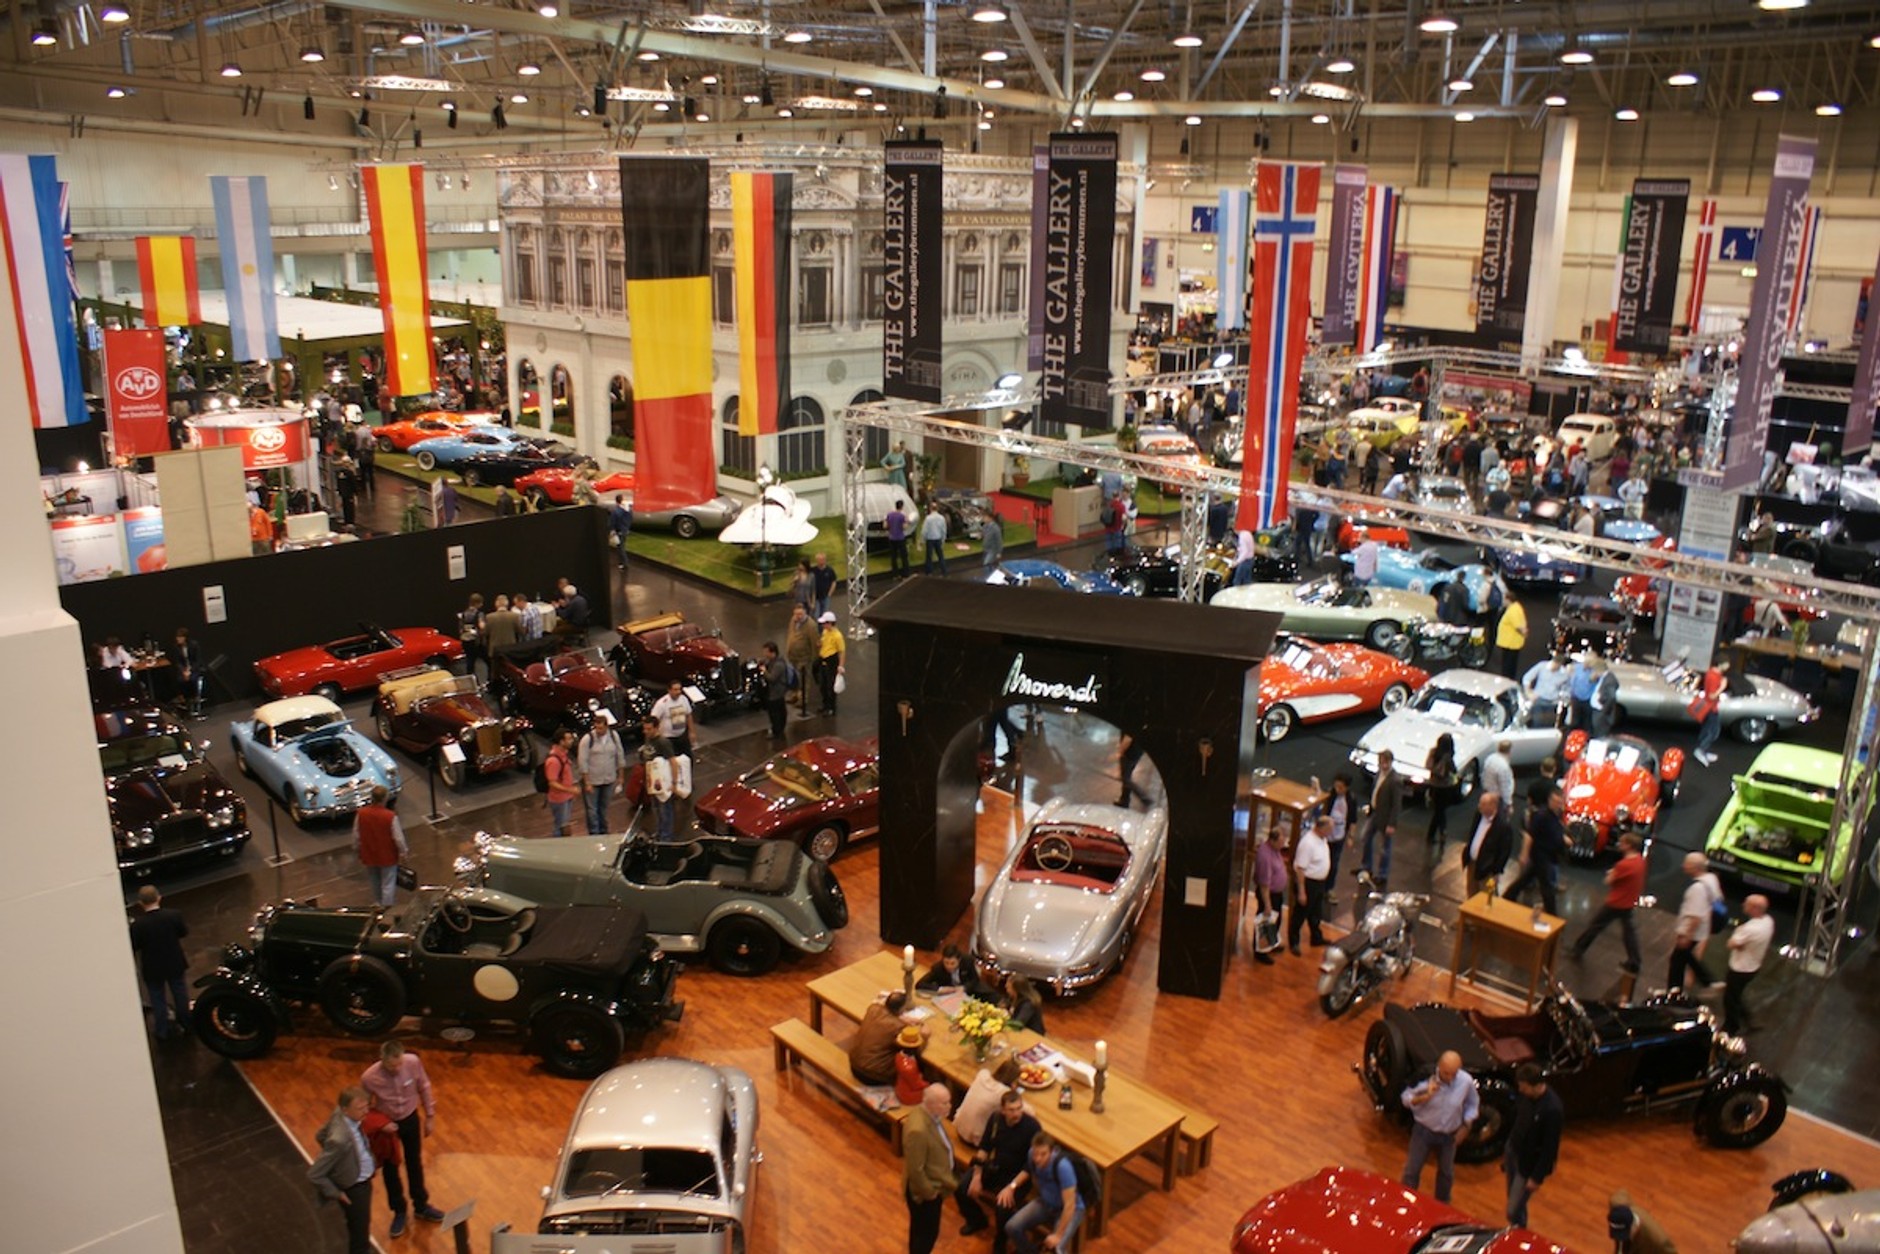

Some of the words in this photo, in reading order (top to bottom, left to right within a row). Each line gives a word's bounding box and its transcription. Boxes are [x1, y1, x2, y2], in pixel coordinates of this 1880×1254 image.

[886, 175, 905, 311] GALLERY
[909, 174, 919, 338] www.thegallerybrummen.nl
[1046, 170, 1072, 324] GALLERY
[1193, 217, 1202, 231] 4
[1481, 194, 1506, 283] GALLERY
[1622, 201, 1650, 293] GALLERY
[1723, 239, 1738, 260] 4
[1073, 169, 1088, 354] www.thegallerybrummen.nl
[1478, 286, 1497, 325] THE
[1617, 299, 1638, 339] THE
[886, 320, 904, 378] THE
[1044, 334, 1066, 399] THE
[1002, 652, 1102, 703] Movendi
